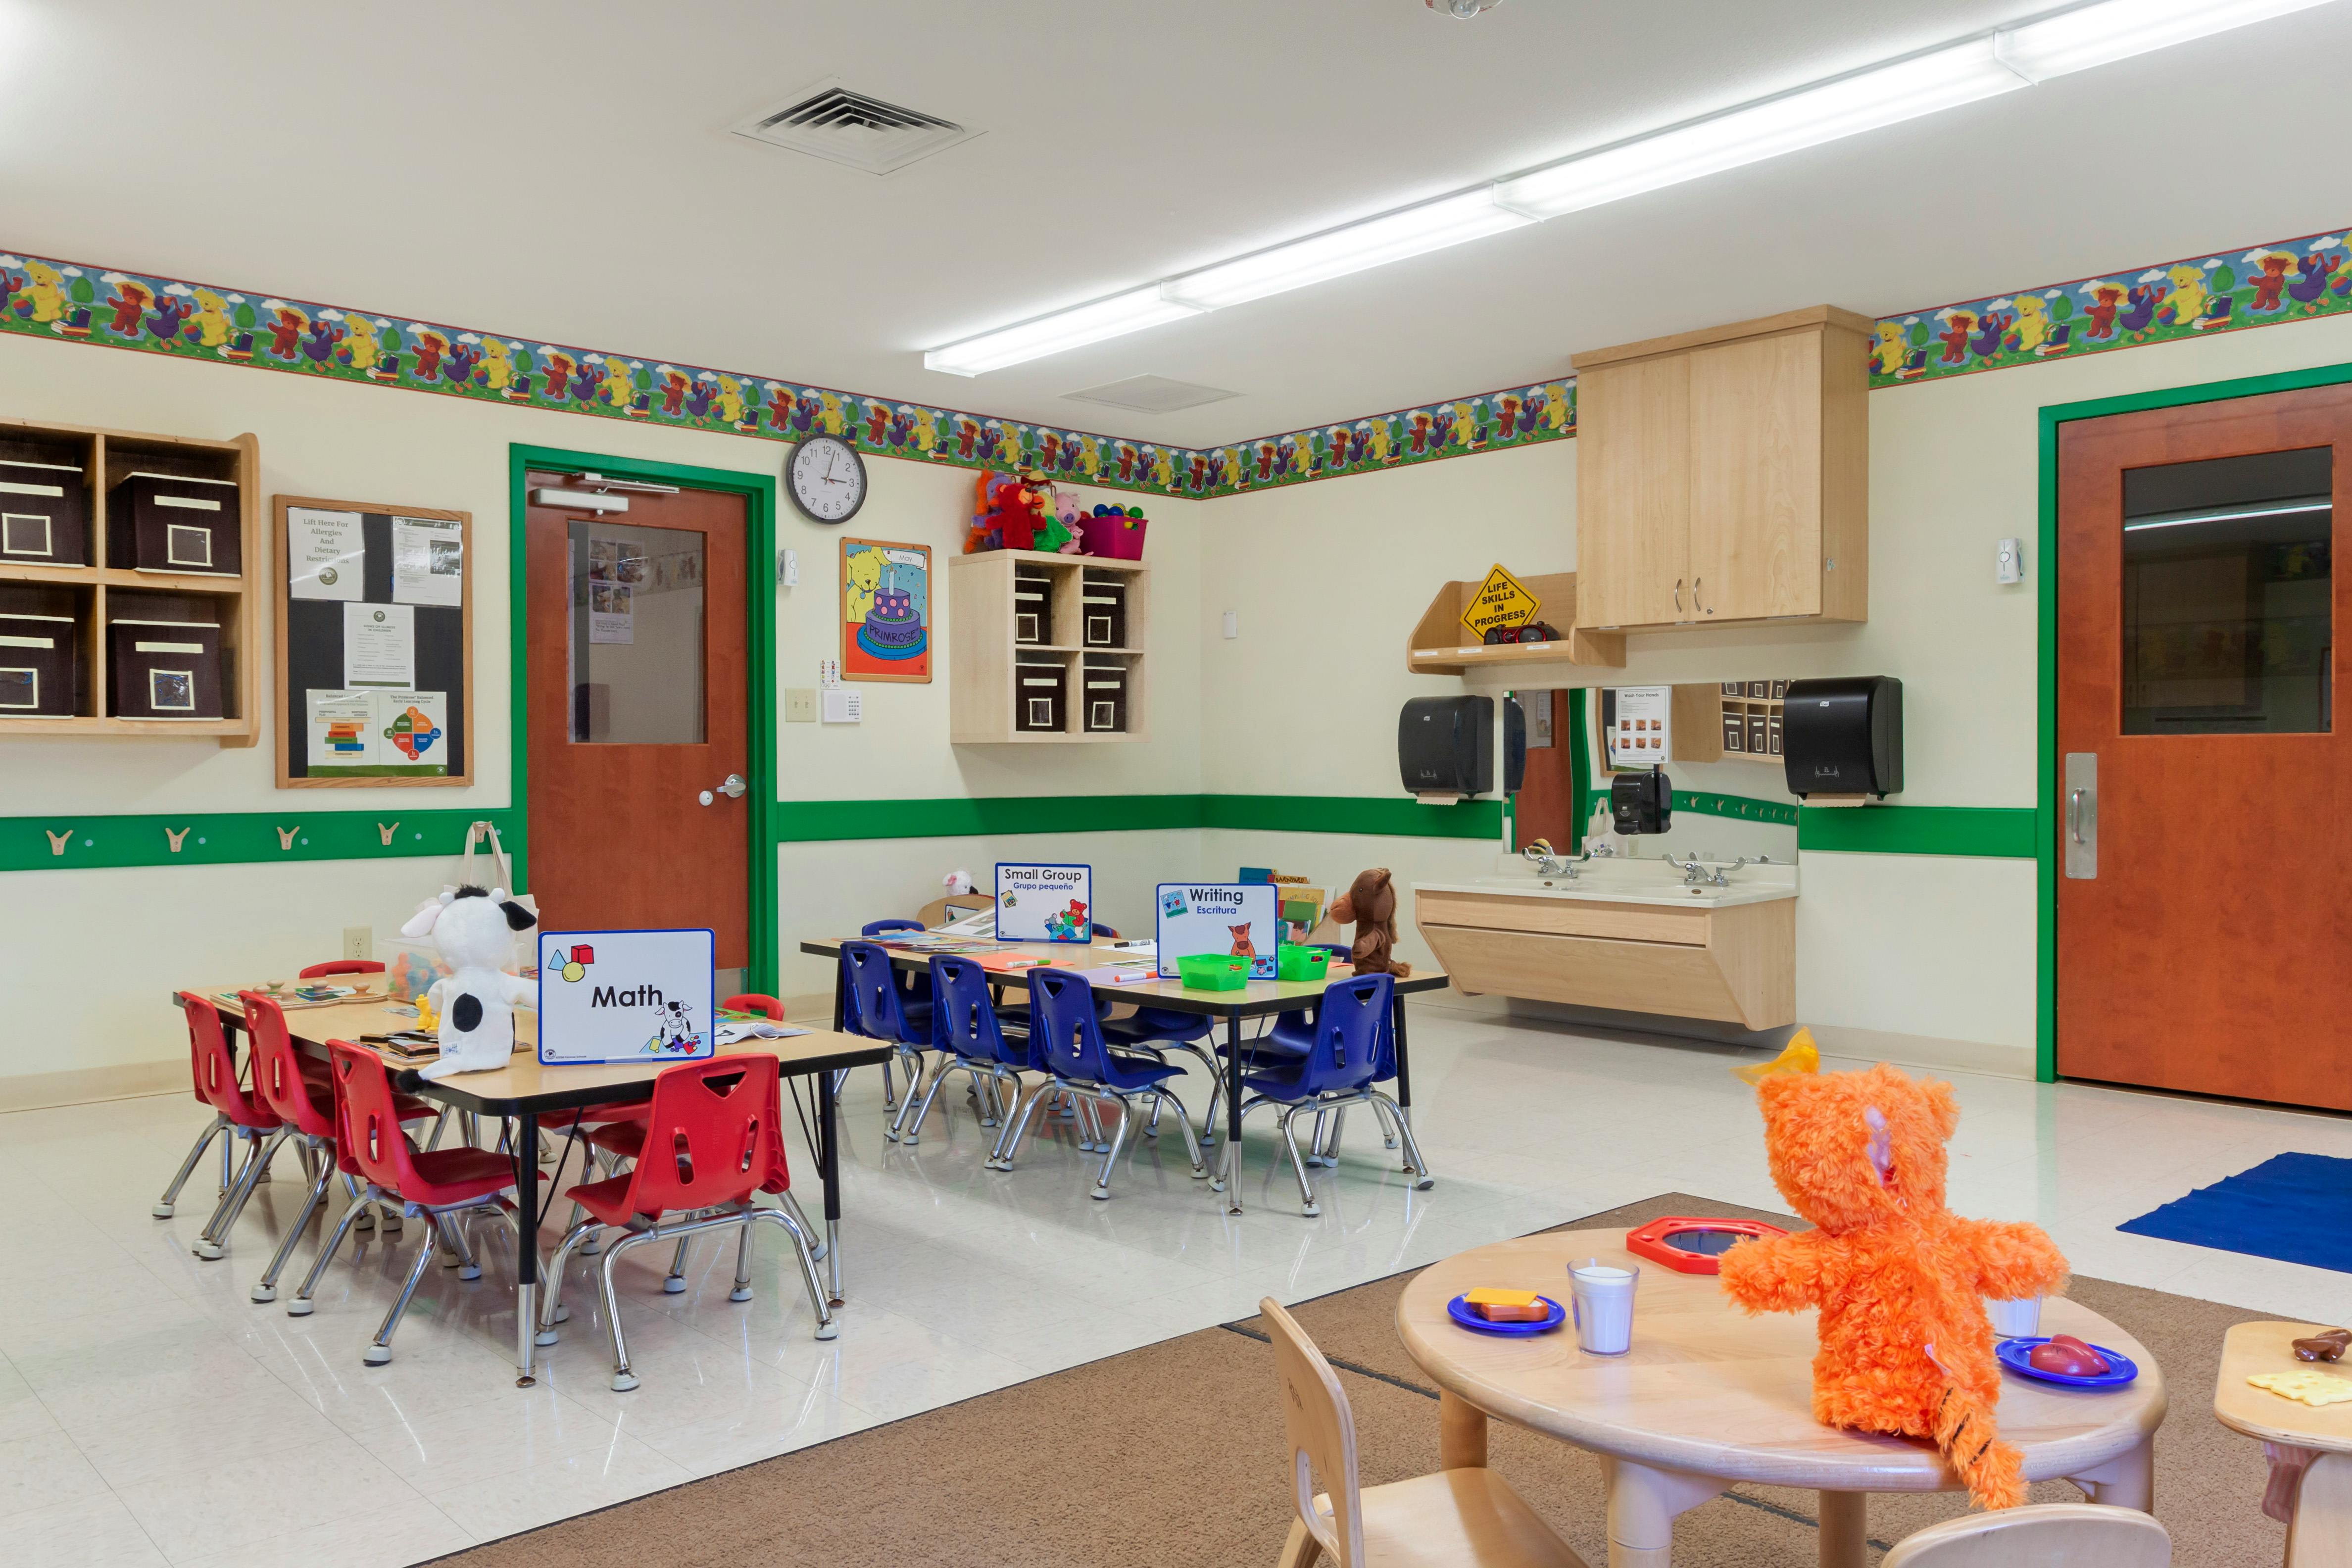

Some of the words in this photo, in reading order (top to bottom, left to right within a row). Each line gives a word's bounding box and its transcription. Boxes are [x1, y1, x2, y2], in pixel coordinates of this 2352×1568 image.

[809, 449, 817, 457] 11
[823, 445, 831, 454] 12
[801, 456, 810, 465] 10
[836, 452, 840, 461] 1
[845, 463, 851, 472] 2
[797, 471, 803, 479] 9
[849, 479, 854, 487] 3
[801, 486, 807, 494] 8
[845, 492, 850, 501] 4
[811, 498, 817, 506] 7
[835, 501, 841, 510] 5
[823, 503, 829, 512] 6
[311, 528, 343, 537] Allergies
[314, 546, 341, 555] Dietary
[1487, 581, 1508, 593] LIFE
[1481, 590, 1516, 605] SKILLS
[1494, 603, 1504, 613] IN
[1474, 609, 1526, 627] PROGRESS
[1005, 868, 1038, 880] Small
[1042, 869, 1081, 882] Group
[1013, 882, 1037, 891] Grupo
[1039, 883, 1074, 891] pequeño
[1189, 888, 1243, 905] Writing
[1197, 906, 1237, 915] Escritura
[591, 984, 664, 1009] Math
